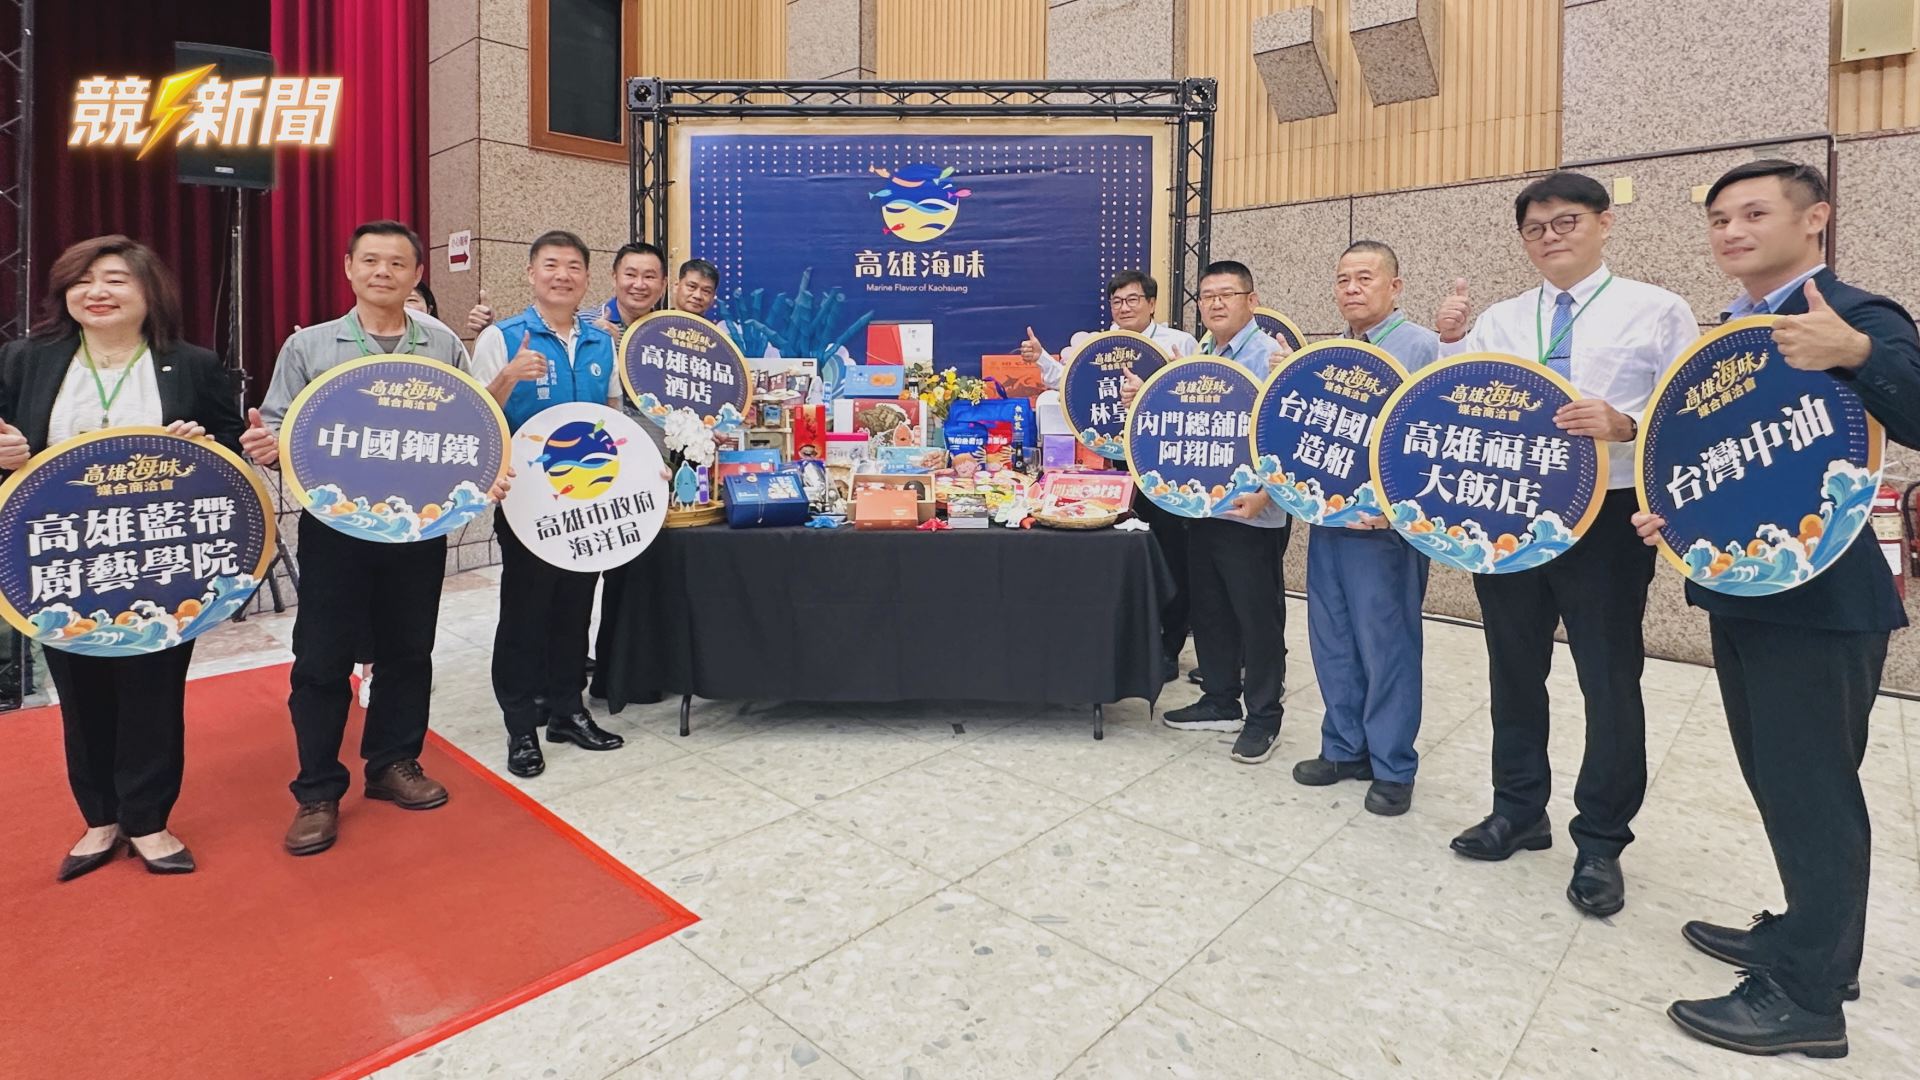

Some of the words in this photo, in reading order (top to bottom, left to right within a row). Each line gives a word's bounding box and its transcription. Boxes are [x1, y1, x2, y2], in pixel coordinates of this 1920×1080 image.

[854, 249, 985, 279] 高雄海味
[866, 284, 892, 292] Marine
[894, 284, 917, 292] Flavor
[918, 284, 927, 292] of
[928, 284, 968, 294] Kaohsiung
[641, 344, 735, 386] 高雄翰品
[1320, 363, 1383, 399] 高雄海味
[1683, 351, 1760, 412] 高雄海味
[369, 377, 447, 401] 高雄海味
[665, 374, 712, 405] 酒店
[1450, 380, 1533, 411] 高雄海味
[317, 423, 481, 467] 中國鋼鐵
[1158, 439, 1235, 468] 阿翔師
[1292, 431, 1356, 480] 造船
[1403, 420, 1572, 476] 高雄福華
[1665, 394, 1836, 511] 台灣中油
[82, 453, 186, 485] 高雄海味
[1415, 464, 1542, 518] 大飯店
[26, 496, 237, 557] 高雄藍帶
[534, 489, 656, 541] 高雄市政府
[568, 521, 641, 561] 海洋局
[30, 538, 240, 604] 廚藝學院
